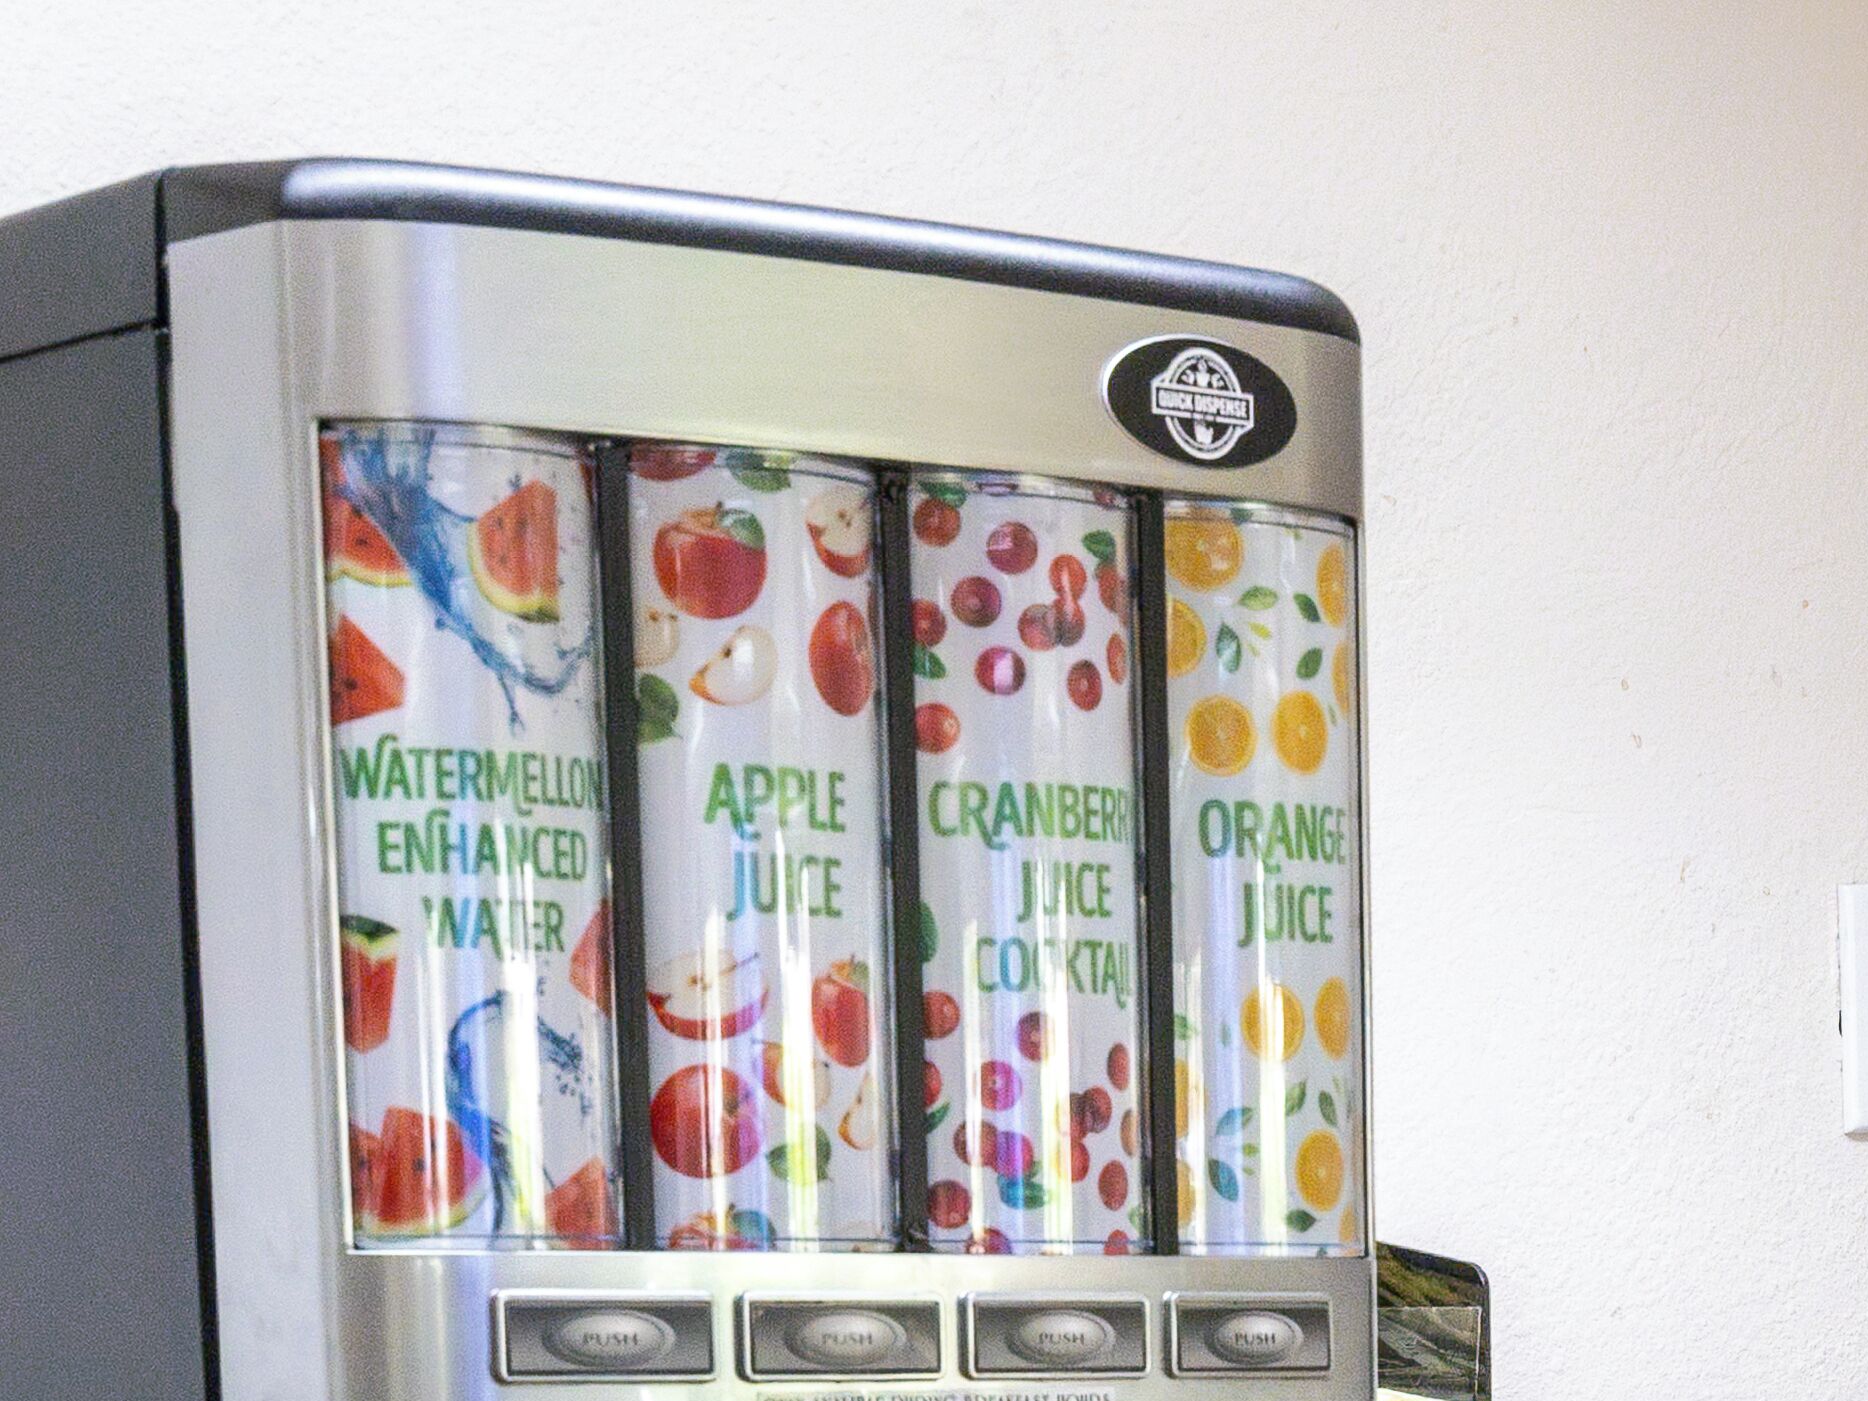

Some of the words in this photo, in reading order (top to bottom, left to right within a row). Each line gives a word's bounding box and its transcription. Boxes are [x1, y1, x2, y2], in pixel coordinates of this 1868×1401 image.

[1159, 389, 1193, 411] QUICK
[1194, 394, 1248, 418] DISPENSE
[703, 762, 846, 840] APPLE
[377, 809, 587, 882] ENHANCED
[1199, 799, 1346, 873] ORANGE
[726, 852, 843, 921] JUICE
[1017, 860, 1112, 923] JUICE
[1238, 882, 1333, 948] JUICE
[422, 895, 565, 958] WATER
[583, 1333, 638, 1346] PUSH
[822, 1333, 872, 1346] PUSH
[1039, 1332, 1085, 1345] PUSH
[1235, 1332, 1275, 1345] PUSH
